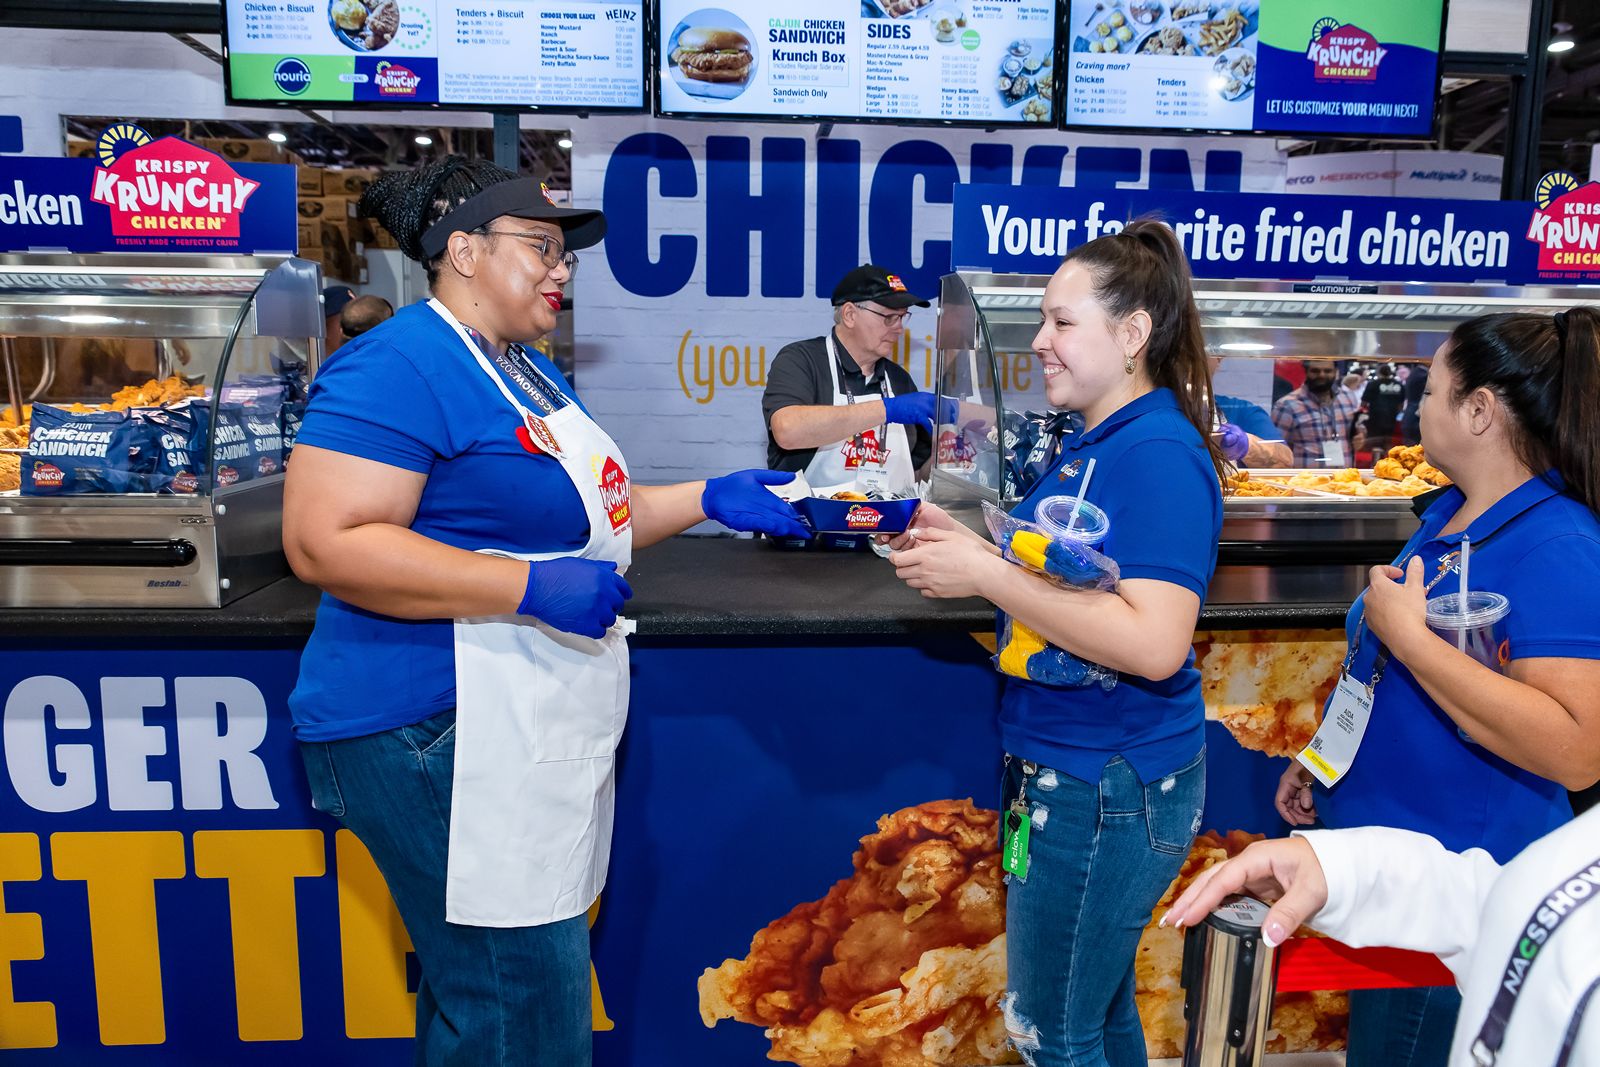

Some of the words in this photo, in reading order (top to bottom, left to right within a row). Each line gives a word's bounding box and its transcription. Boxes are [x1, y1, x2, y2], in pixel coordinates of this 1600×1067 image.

[244, 3, 276, 12] Chicken
[287, 4, 314, 12] Biscuit
[456, 8, 487, 18] Tenders
[497, 9, 524, 18] Biscuit
[563, 12, 578, 20] YOUR
[606, 8, 636, 22] HEINZ
[768, 18, 800, 28] CAJUN
[804, 20, 845, 30] CHICKEN
[768, 29, 846, 44] SANDWICH
[867, 24, 911, 39] SIDES
[1330, 37, 1366, 45] KRISPY
[772, 49, 818, 62] Krunch
[822, 51, 846, 63] Box
[1307, 42, 1388, 68] KRUNCHY
[1076, 62, 1104, 71] Craving
[1324, 68, 1368, 76] CHICKEN
[274, 70, 311, 82] nouria
[375, 74, 421, 88] KRUNCHY
[1075, 76, 1104, 84] Chicken
[1158, 78, 1186, 87] Tenders
[773, 88, 809, 97] Sandwich
[812, 89, 828, 98] Only
[1266, 100, 1280, 114] LET
[1282, 100, 1294, 114] US
[1295, 101, 1340, 116] CUSTOMIZE
[1342, 102, 1367, 116] YOUR
[1369, 104, 1392, 117] MENU
[1394, 104, 1418, 118] NEXT!
[135, 160, 210, 174] KRISPY
[94, 170, 256, 214] KRUNCHY
[131, 216, 222, 230] CHICKEN
[116, 238, 146, 246] FRESHLY
[148, 238, 168, 246] MADE
[982, 204, 1076, 256] Your
[1255, 206, 1353, 264] fried
[1359, 211, 1510, 268] chicken
[1310, 286, 1344, 294] CAUTION
[1346, 286, 1361, 294] HOT
[34, 427, 113, 443] CHICKEN
[28, 442, 108, 458] SANDWICH
[32, 472, 65, 480] KRUNCHY
[846, 514, 884, 522] KRUNCHY
[4, 675, 279, 812] GER
[1011, 830, 1020, 858] clov
